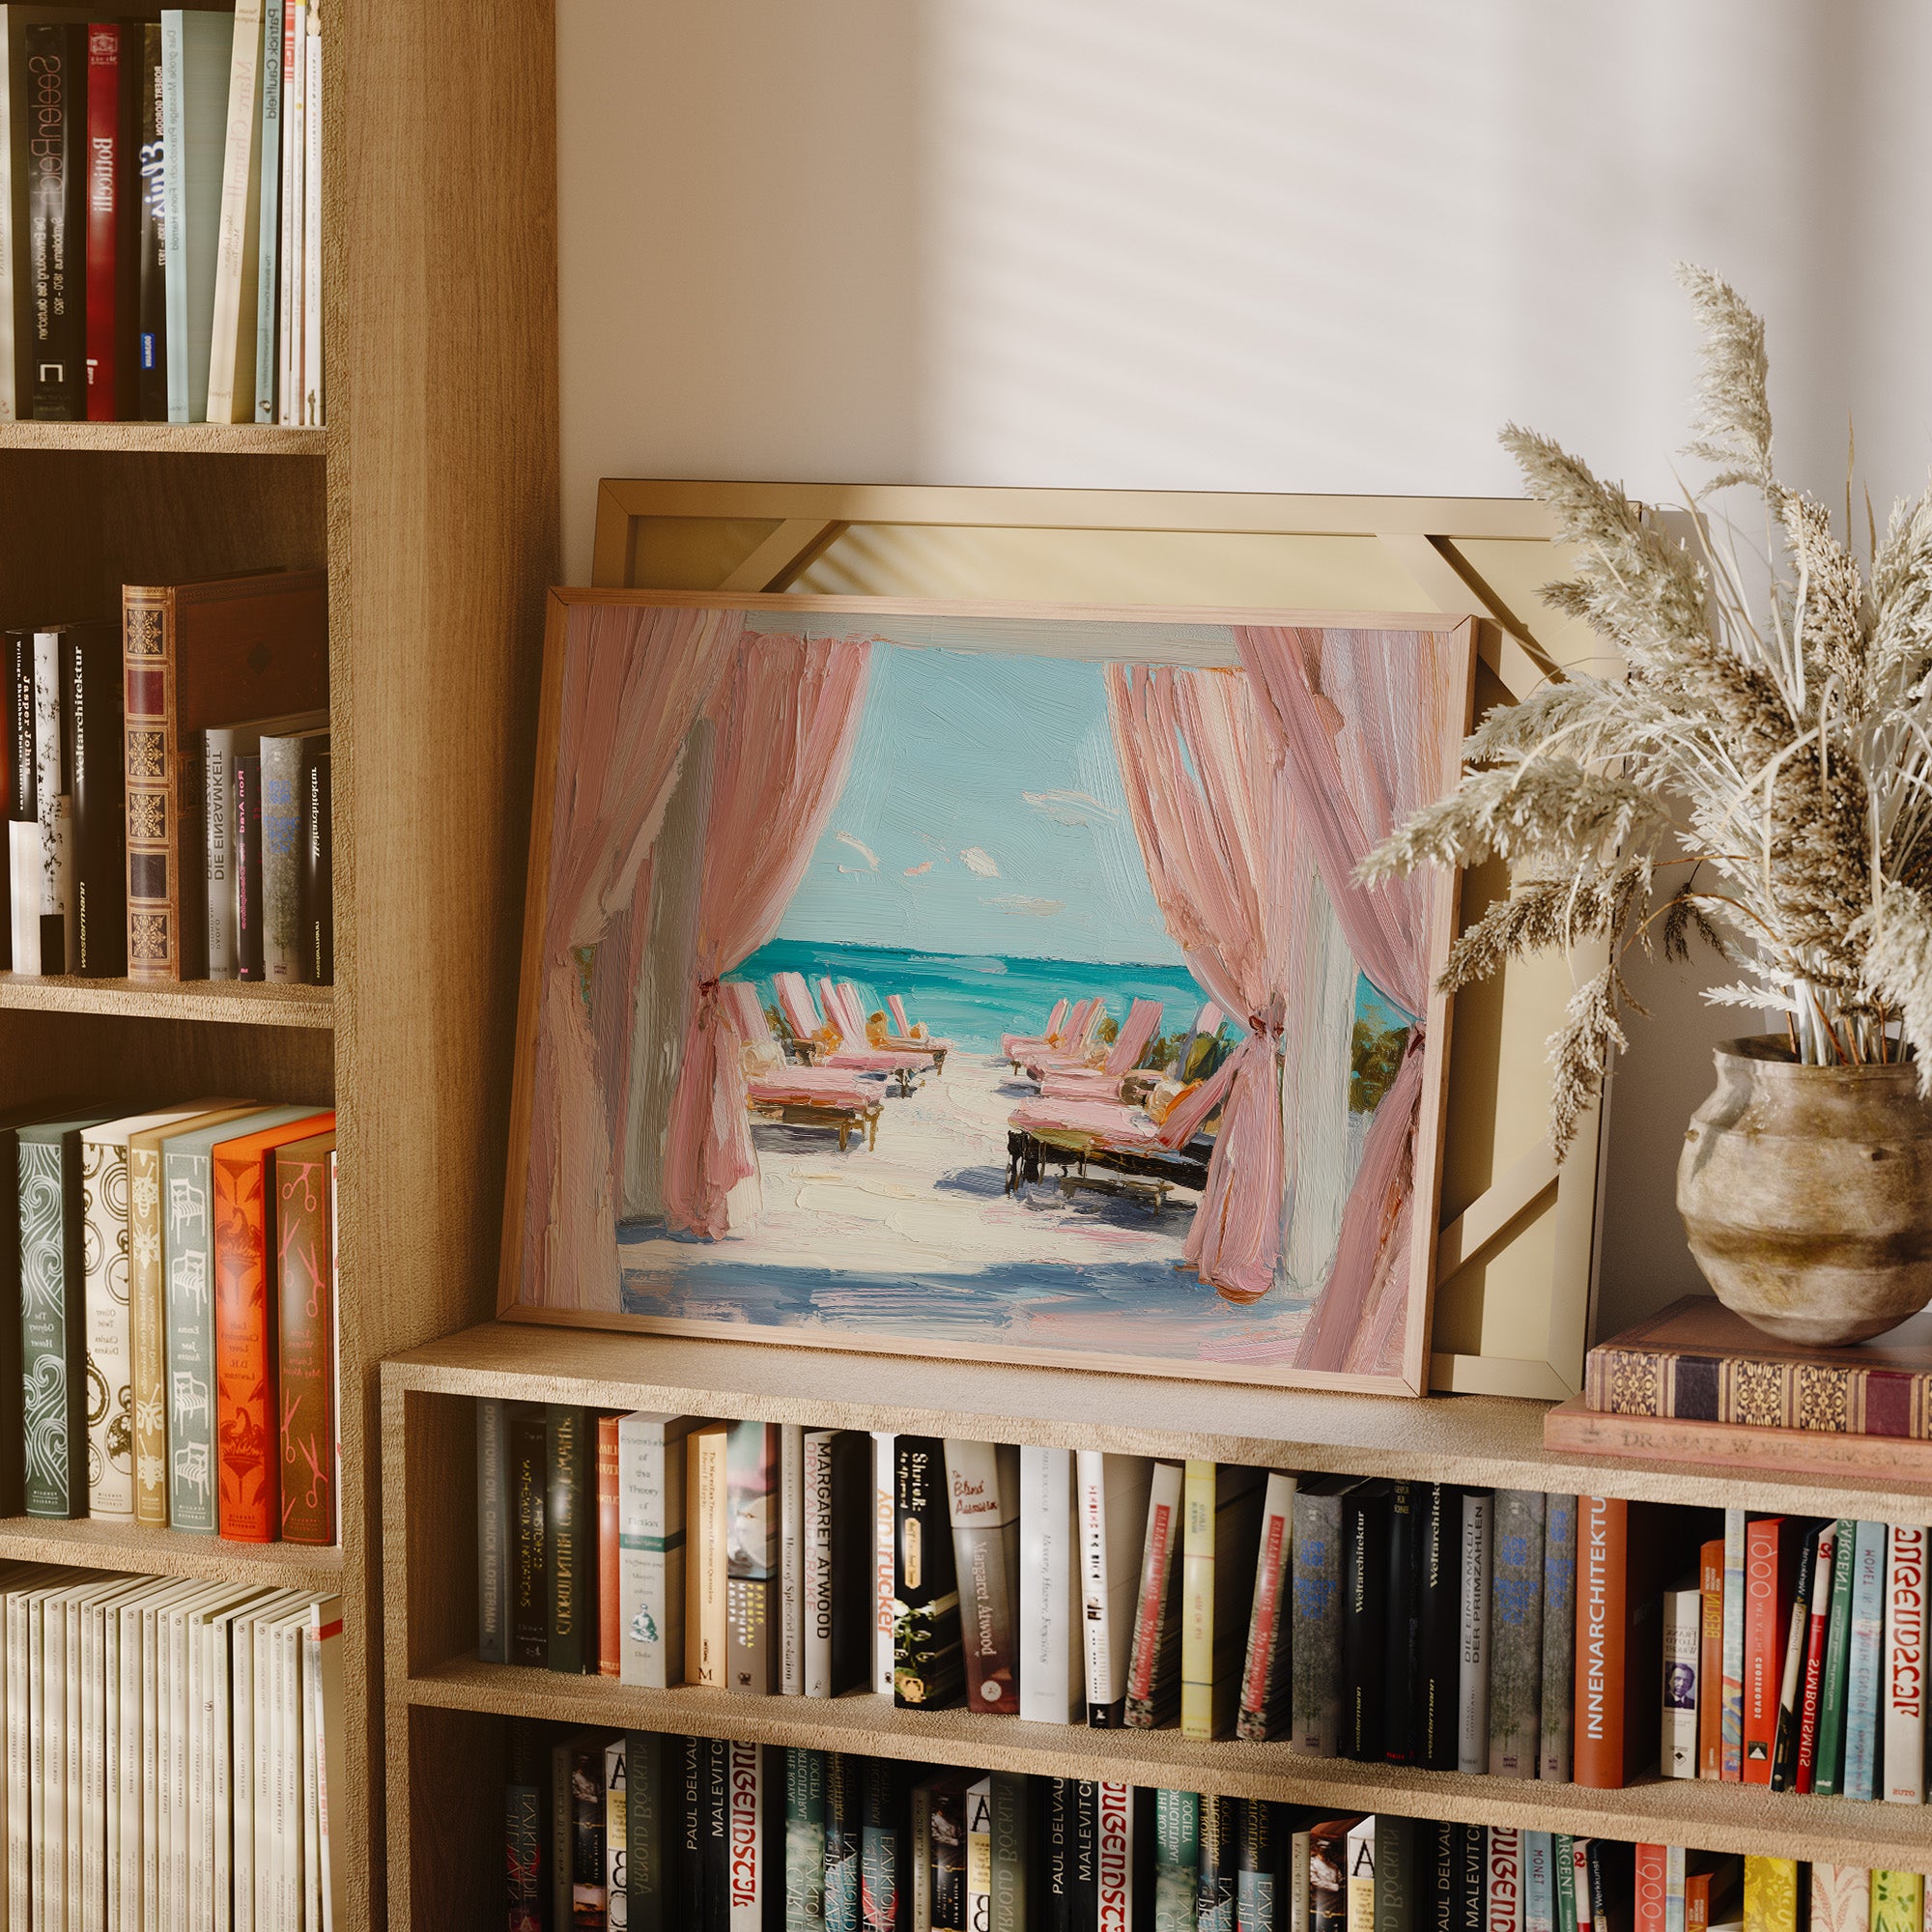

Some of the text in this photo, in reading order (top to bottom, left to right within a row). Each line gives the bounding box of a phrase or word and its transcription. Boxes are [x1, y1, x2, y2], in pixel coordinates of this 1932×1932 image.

[22, 676, 33, 775] Jasper Johns
[73, 645, 85, 783] Weltarchitektur
[79, 882, 88, 968] westermann
[636, 1469, 651, 1478] the
[639, 1453, 649, 1462] of
[912, 1453, 930, 1512] Shriek:
[1623, 1433, 1721, 1451] DRAMAT
[1733, 1438, 1753, 1455] W
[484, 1406, 497, 1633] DOWNTOWN OWL CHUCK KLOSTERMAN
[628, 1516, 659, 1528] Fiction
[629, 1485, 658, 1497] Theory
[639, 1502, 649, 1511] of
[806, 1441, 817, 1612] ORYX AND CRAKE
[952, 1480, 985, 1497] Blind
[817, 1442, 832, 1640] MARGARET ATWOOD
[1355, 1511, 1366, 1614] Weltarchitektur
[1464, 1521, 1474, 1630] EINSAMKEIT
[783, 1537, 796, 1681] House of Splendid Isolation
[972, 1541, 998, 1656] Margaret Atwood
[1472, 1506, 1483, 1664] DER PRIMZAHLEN
[1587, 1498, 1606, 1741] INNENARCHITEKTU
[698, 1666, 713, 1681] M
[1354, 1687, 1363, 1751] westermann
[1427, 1679, 1436, 1759] westermann
[686, 1736, 696, 1851] PAUL DELVAU
[1053, 1777, 1064, 1894] PAUL DELVAU
[1438, 1821, 1450, 1932] AUL DELVAU
[1533, 1849, 1544, 1902] MONET IN
[1559, 1834, 1574, 1898] ARGENT
[1592, 1861, 1603, 1908] Werkkunst
[1636, 1856, 1662, 1919] 1900
